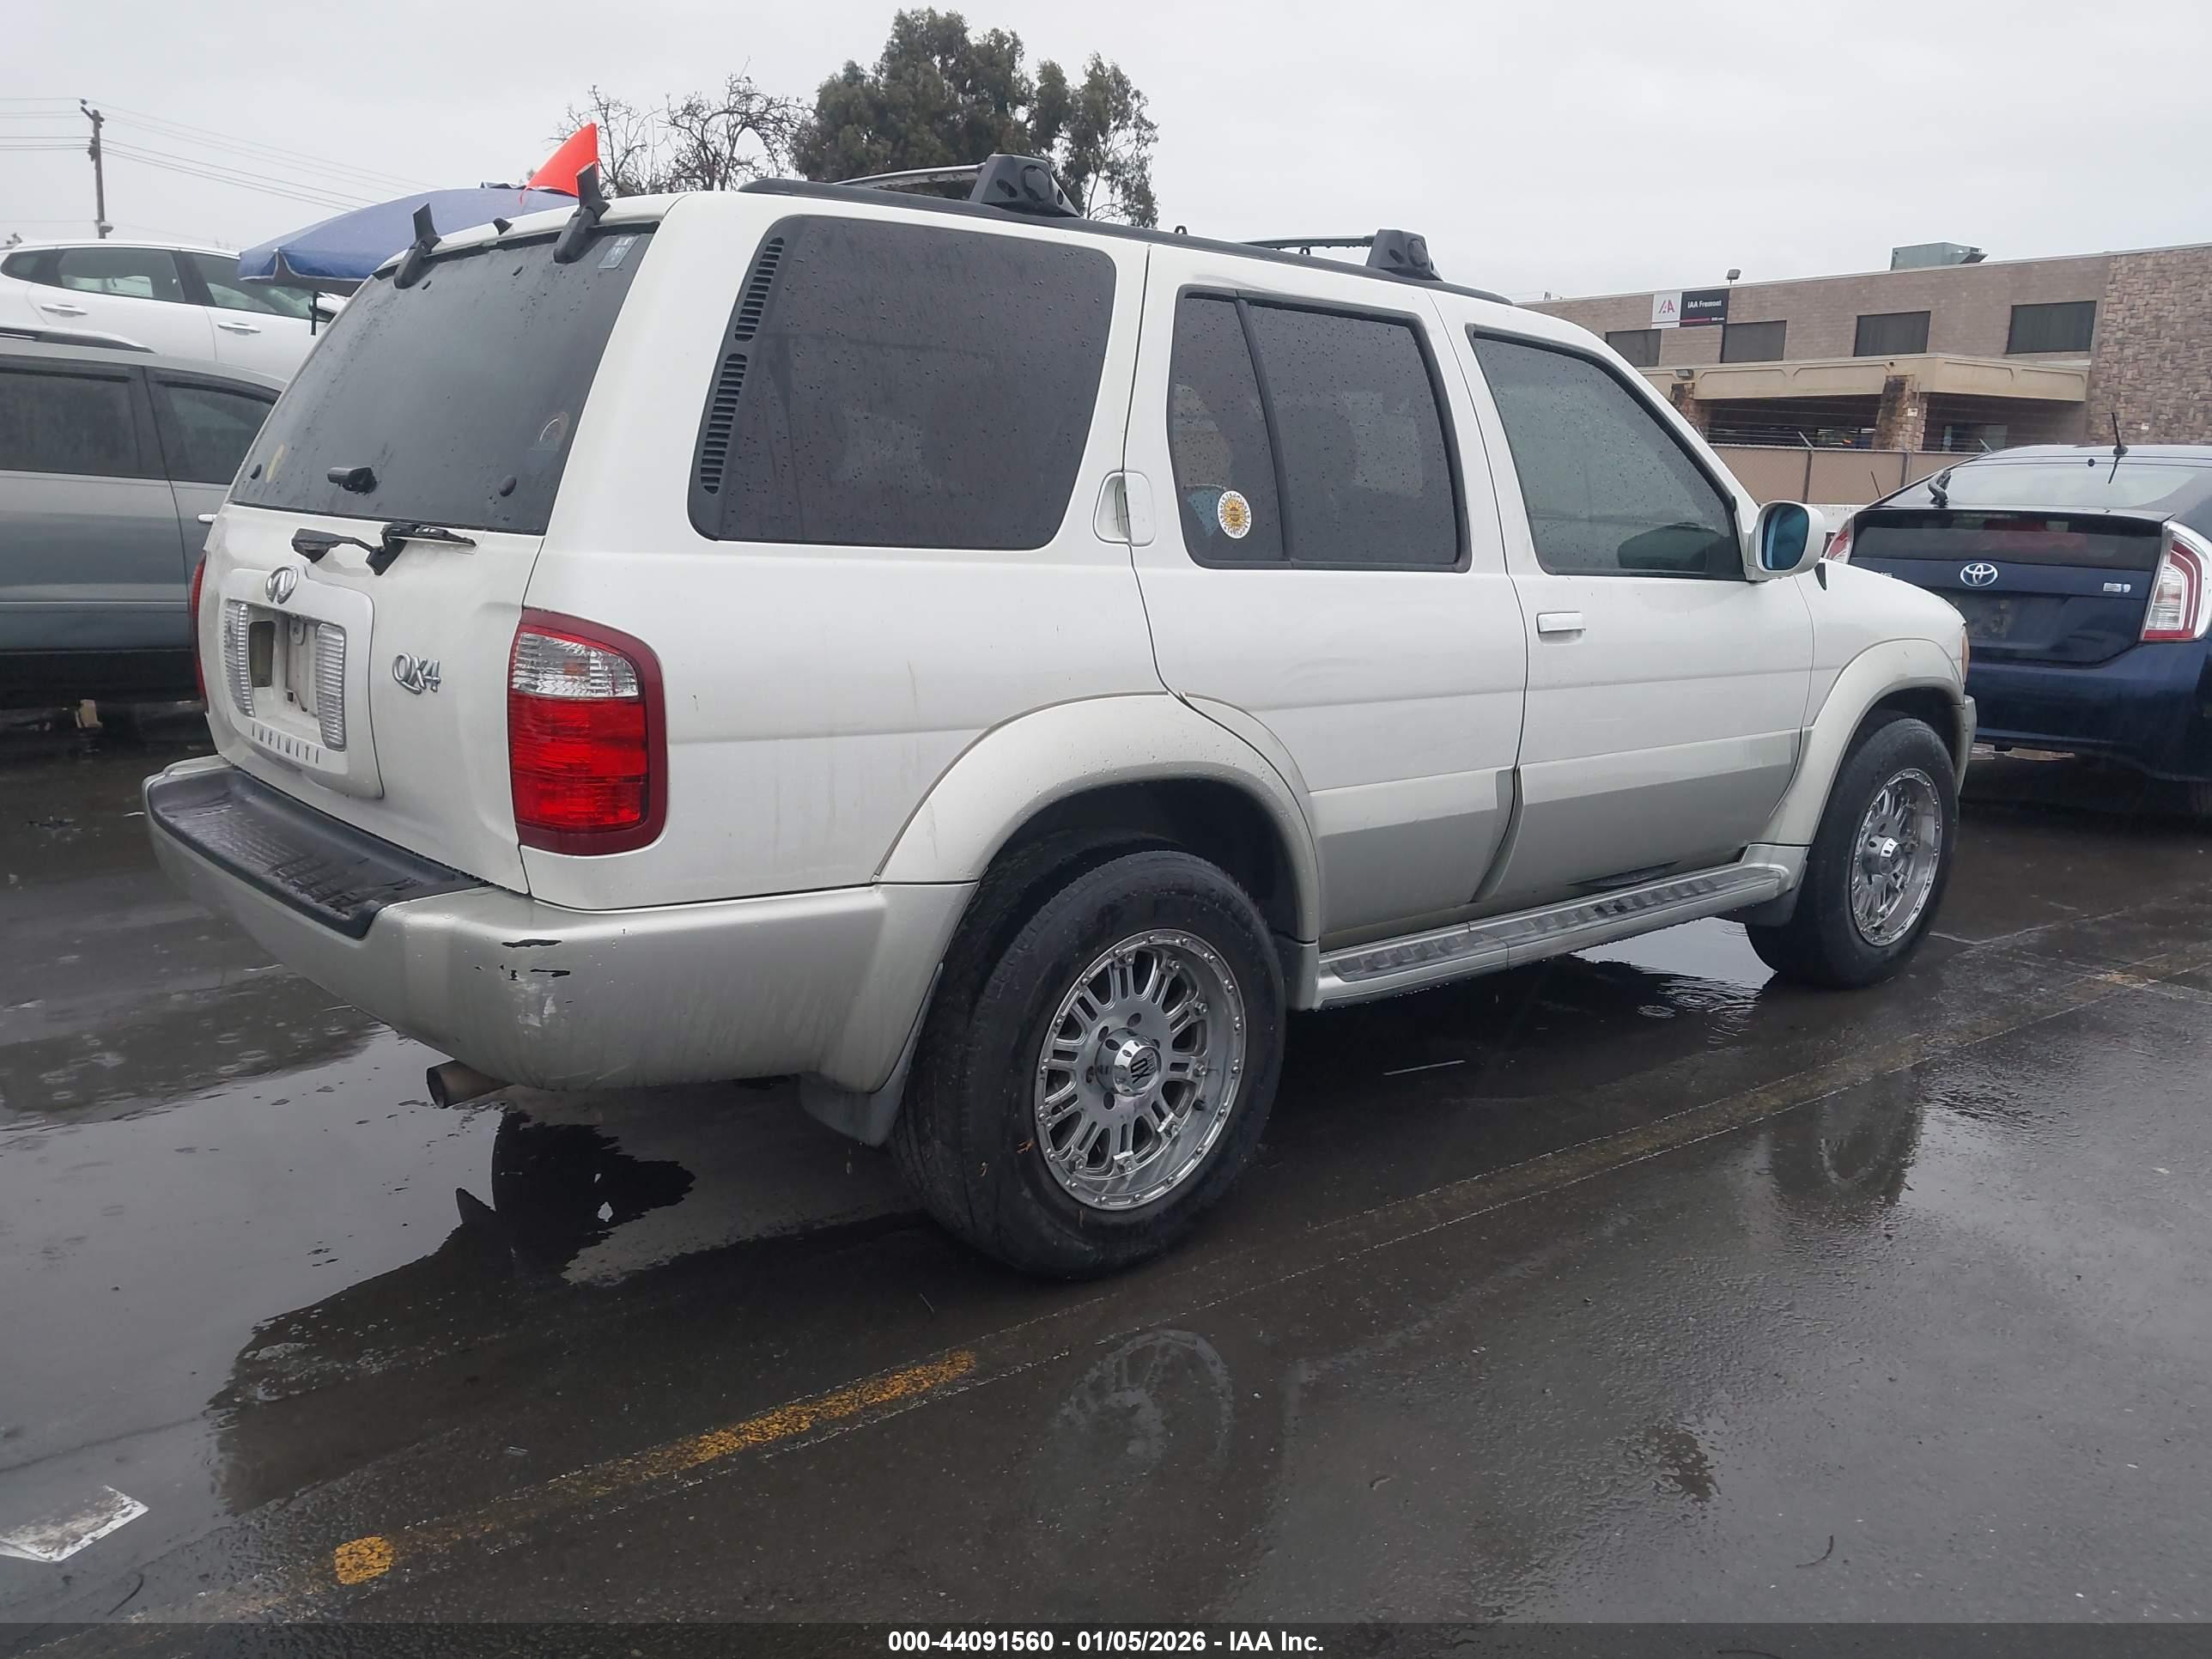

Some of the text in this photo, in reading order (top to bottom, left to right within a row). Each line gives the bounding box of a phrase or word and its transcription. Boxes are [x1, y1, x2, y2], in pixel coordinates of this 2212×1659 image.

[1687, 299, 1723, 309] IAA Fremont
[392, 653, 441, 695] QX4
[252, 723, 319, 764] INFINITI
